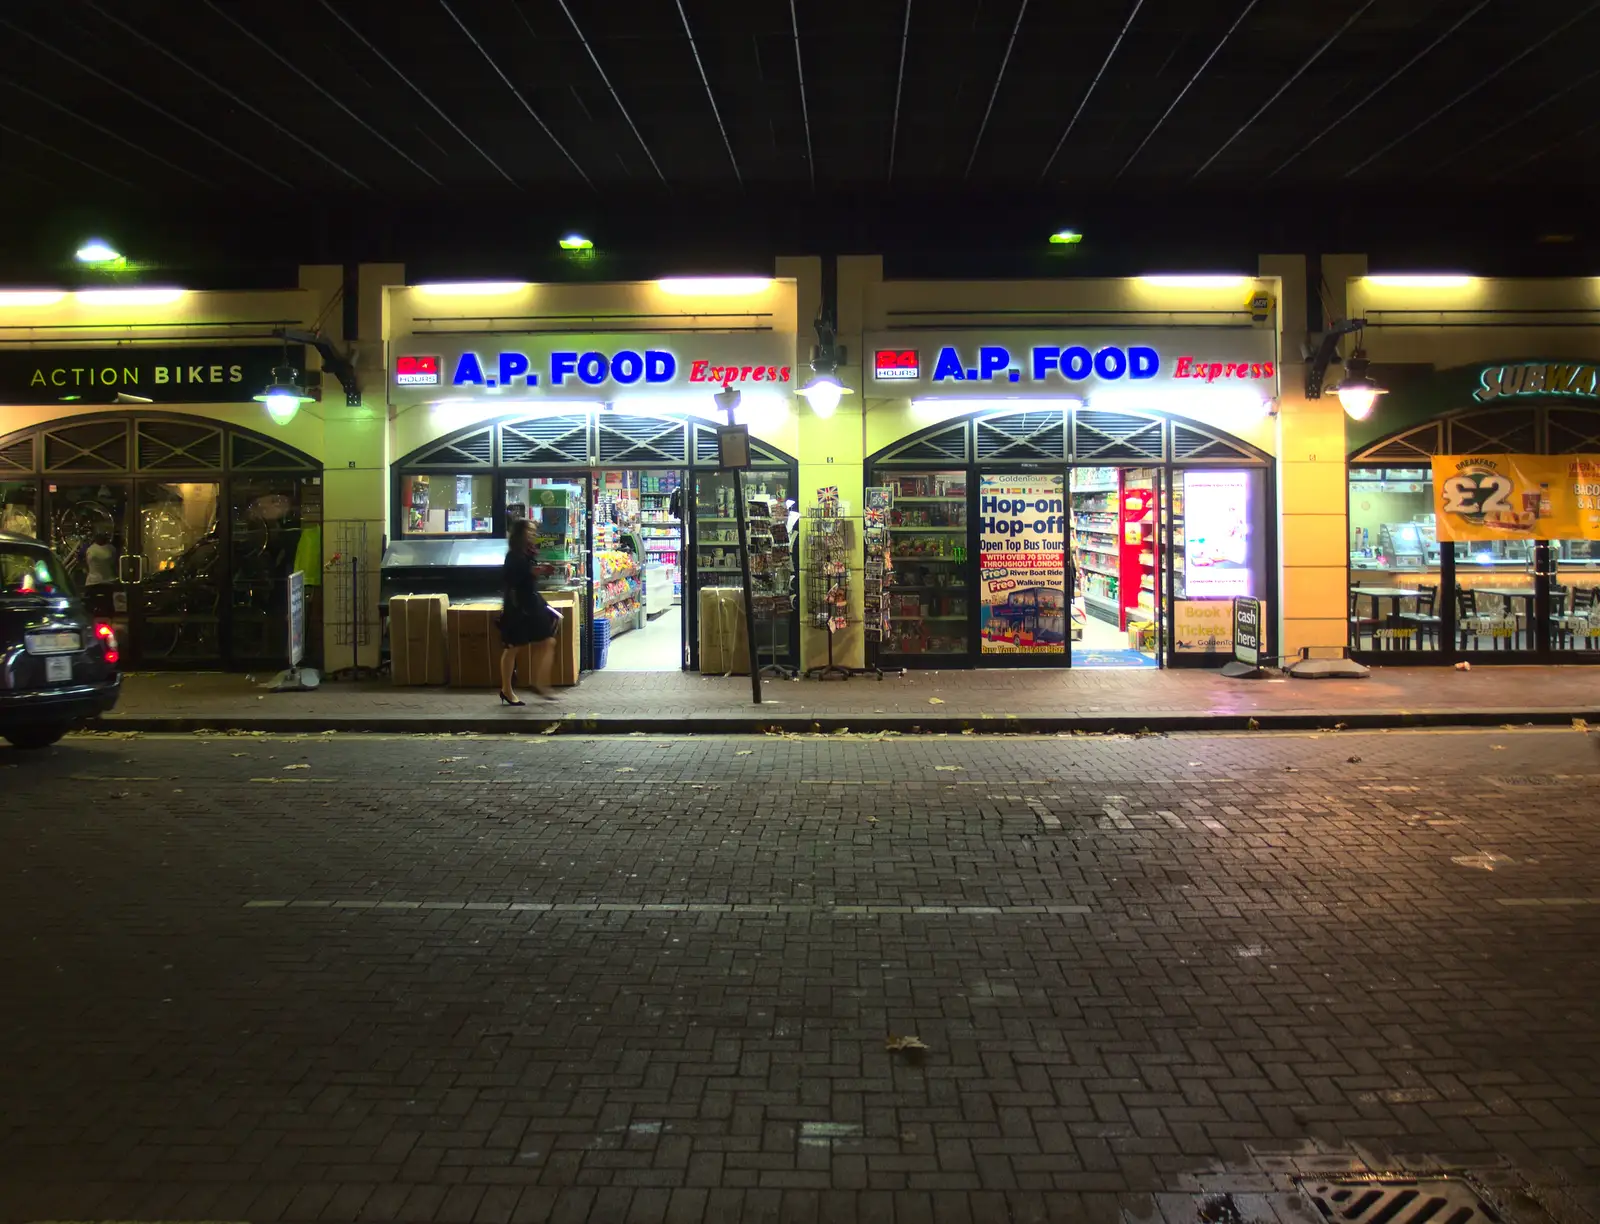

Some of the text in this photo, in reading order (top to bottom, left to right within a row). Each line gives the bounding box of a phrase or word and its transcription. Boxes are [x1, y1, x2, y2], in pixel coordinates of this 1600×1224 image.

[876, 351, 917, 368] 24
[933, 346, 1275, 383] A.P. FOOD Express
[30, 365, 244, 387] ACTION BIKES
[453, 350, 791, 388] A.P. FOOD Express
[878, 369, 917, 377] HOURS
[399, 375, 437, 383] HOURS
[1472, 364, 1600, 402] SUBWA
[1455, 458, 1498, 471] BREAKFAST
[999, 475, 1048, 483] GoldenTours
[1442, 476, 1513, 514] £2
[981, 496, 1062, 516] Hop-on
[980, 516, 1064, 537] Hop-off
[980, 539, 1064, 552] Open Top Bus Tours
[982, 568, 1008, 580] Free
[989, 580, 1015, 592] Free
[1016, 579, 1045, 587] Walking
[1185, 606, 1220, 618] Book
[1237, 609, 1256, 625] cash
[1177, 624, 1226, 636] Tickets
[1237, 628, 1256, 646] here
[1373, 628, 1418, 638] SUBWAY
